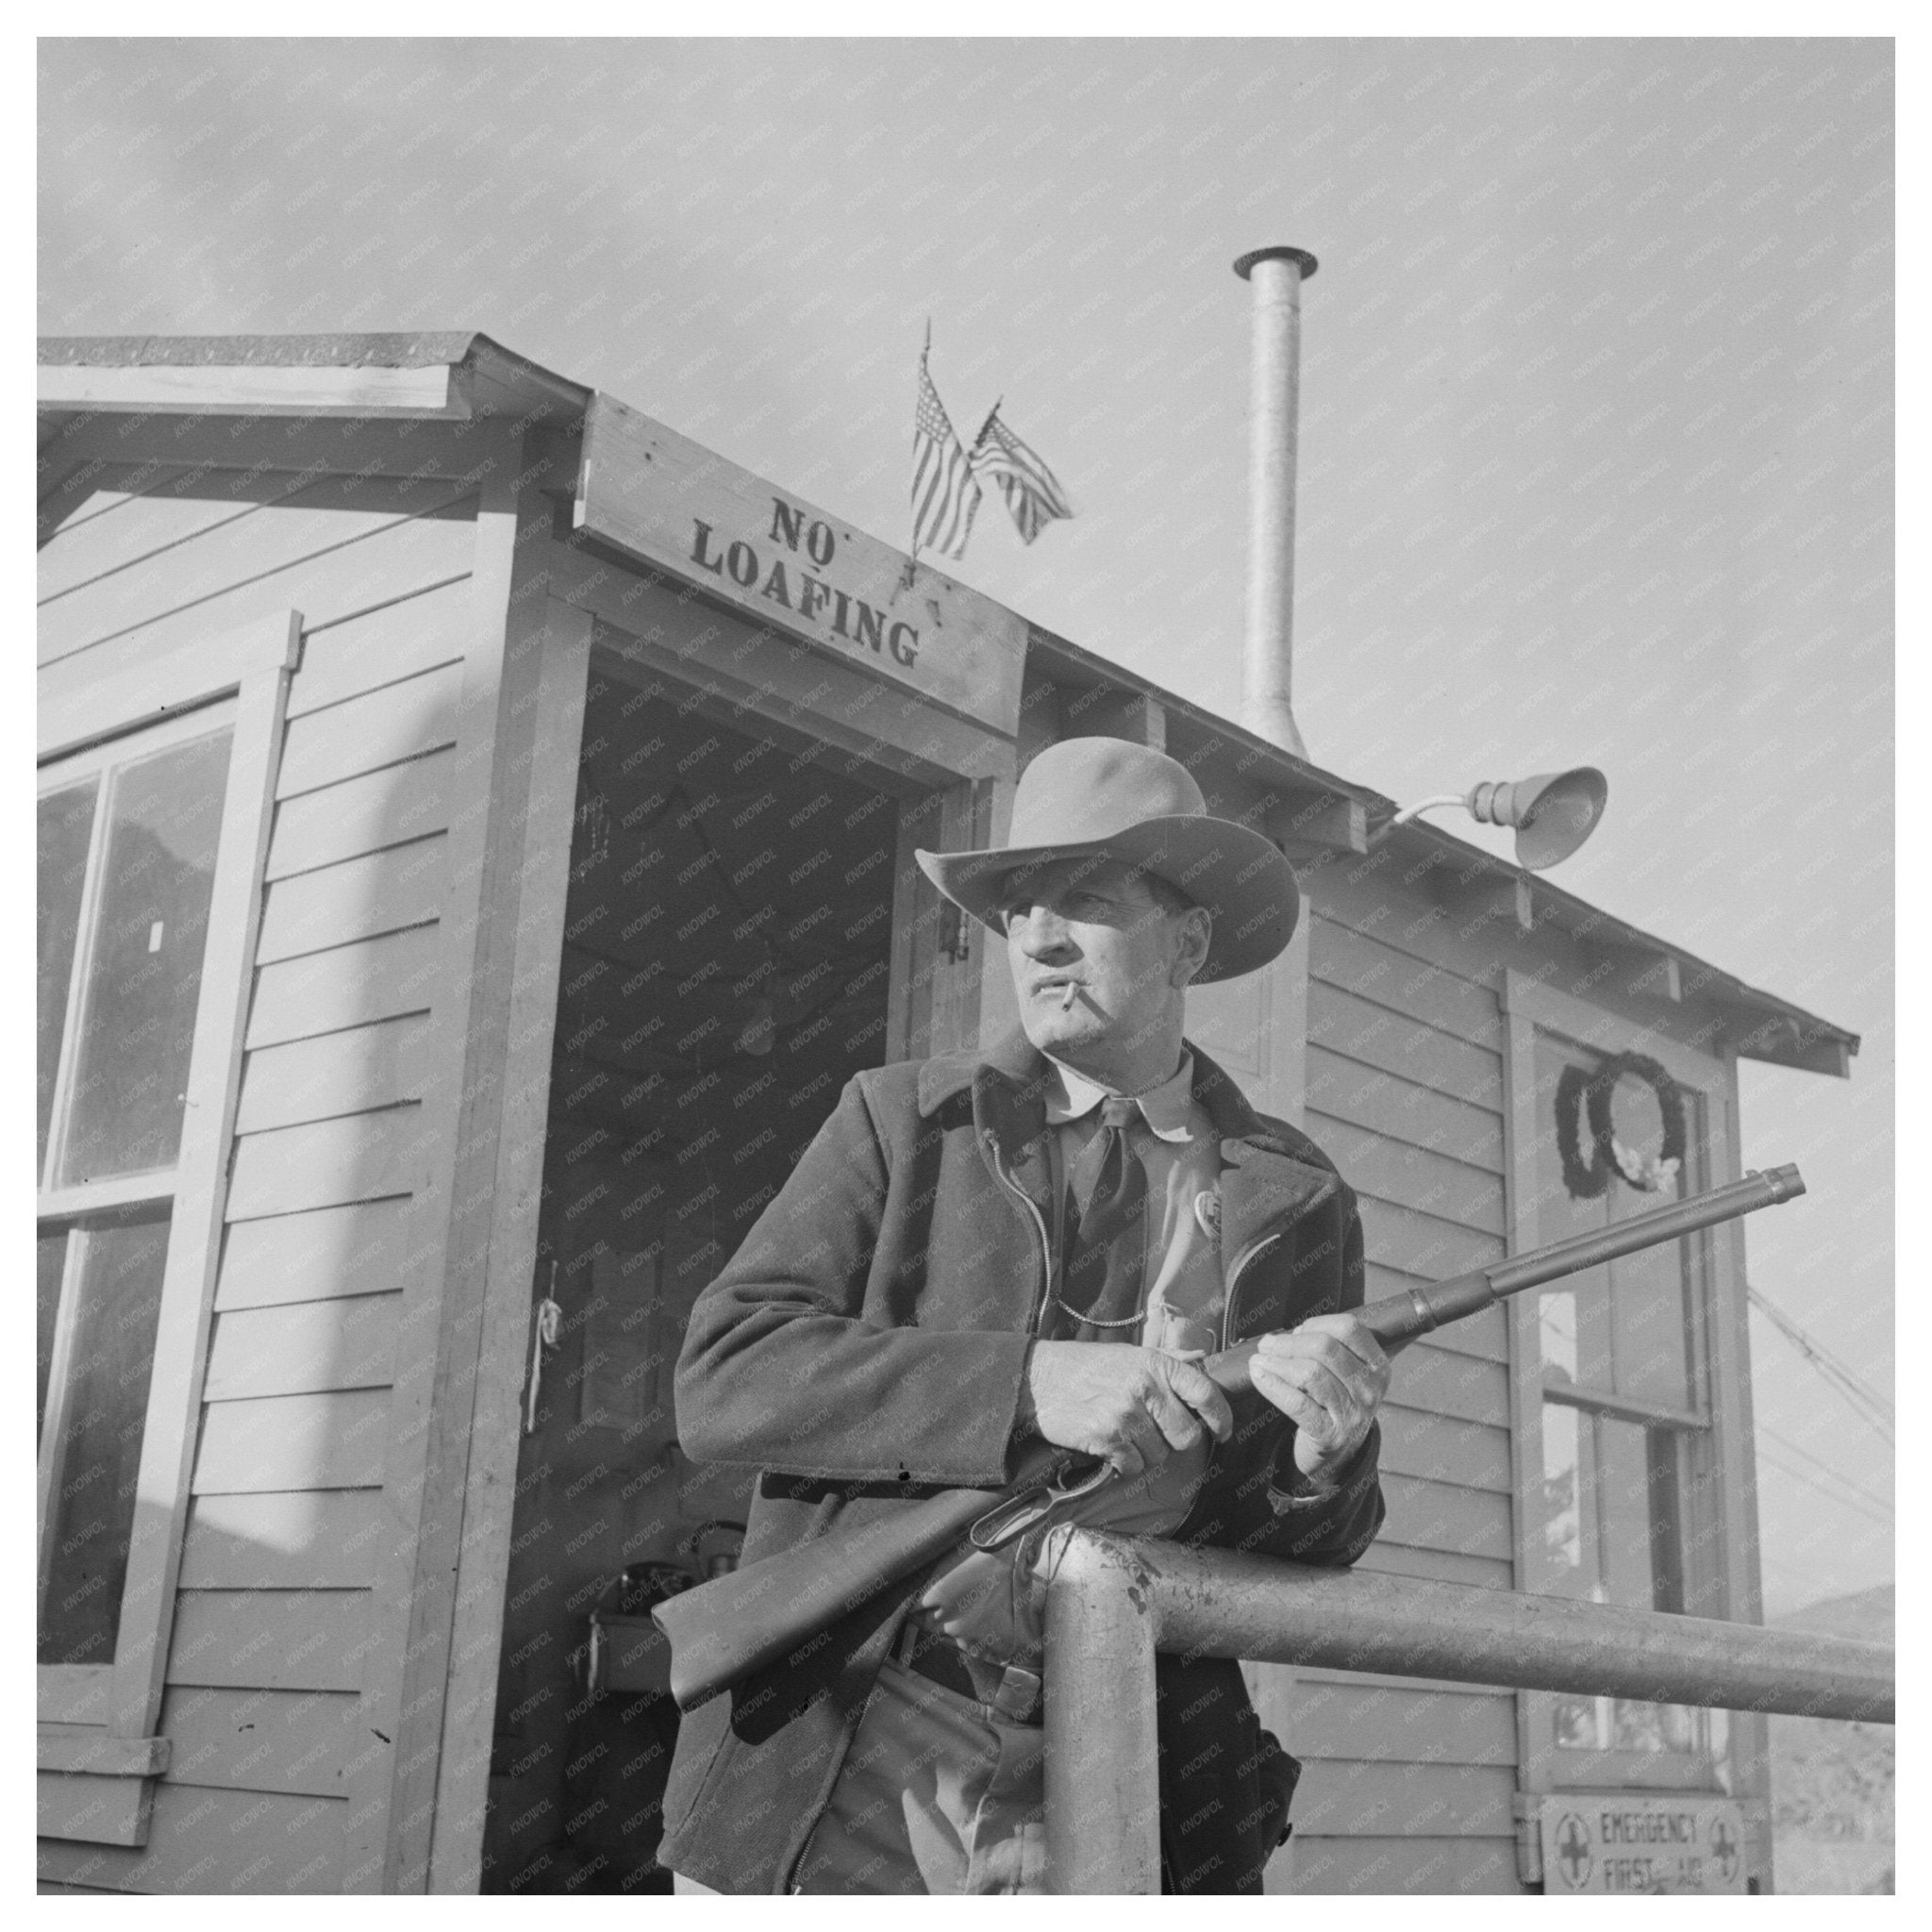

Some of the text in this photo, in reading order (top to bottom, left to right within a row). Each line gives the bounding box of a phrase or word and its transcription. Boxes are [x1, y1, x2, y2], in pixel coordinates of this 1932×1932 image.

[768, 496, 835, 566] NO
[690, 518, 919, 669] LOAFING
[1601, 1813, 1697, 1843] EMERGENCY
